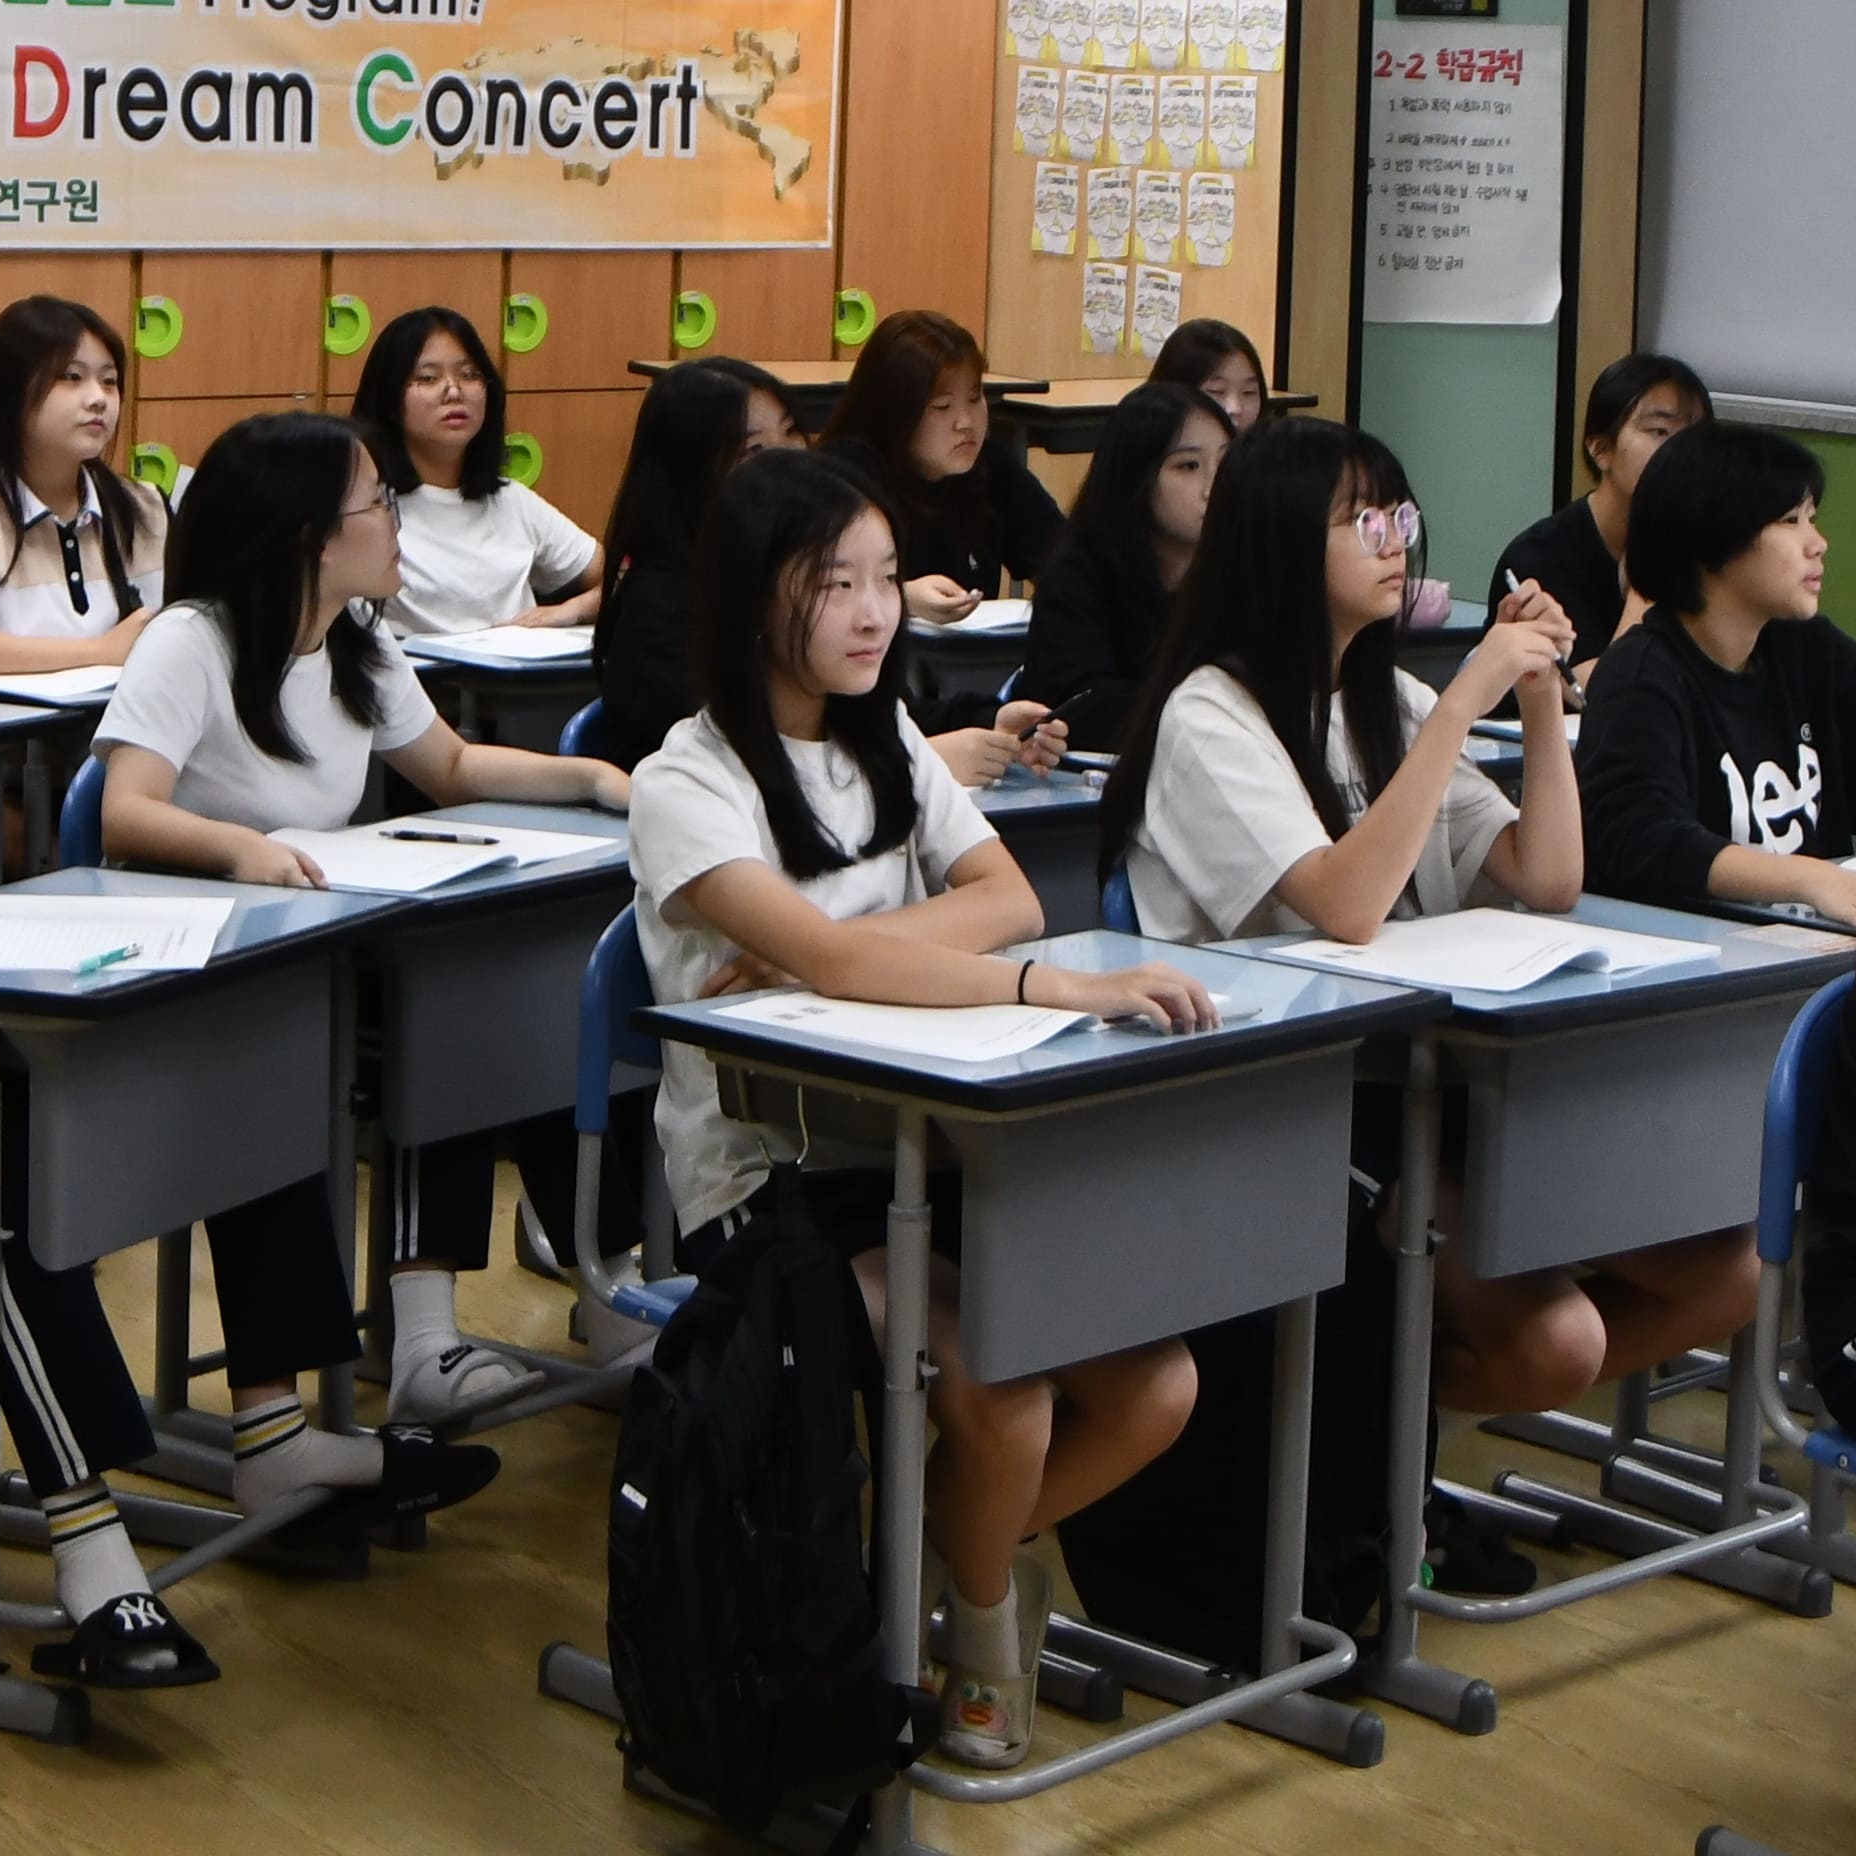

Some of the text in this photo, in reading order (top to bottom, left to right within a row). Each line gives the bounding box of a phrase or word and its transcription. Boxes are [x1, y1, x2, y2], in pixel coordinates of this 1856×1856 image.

[12, 45, 313, 143] Dream
[356, 53, 699, 151] Concert
[1374, 47, 1524, 86] 2-2 학급규칙
